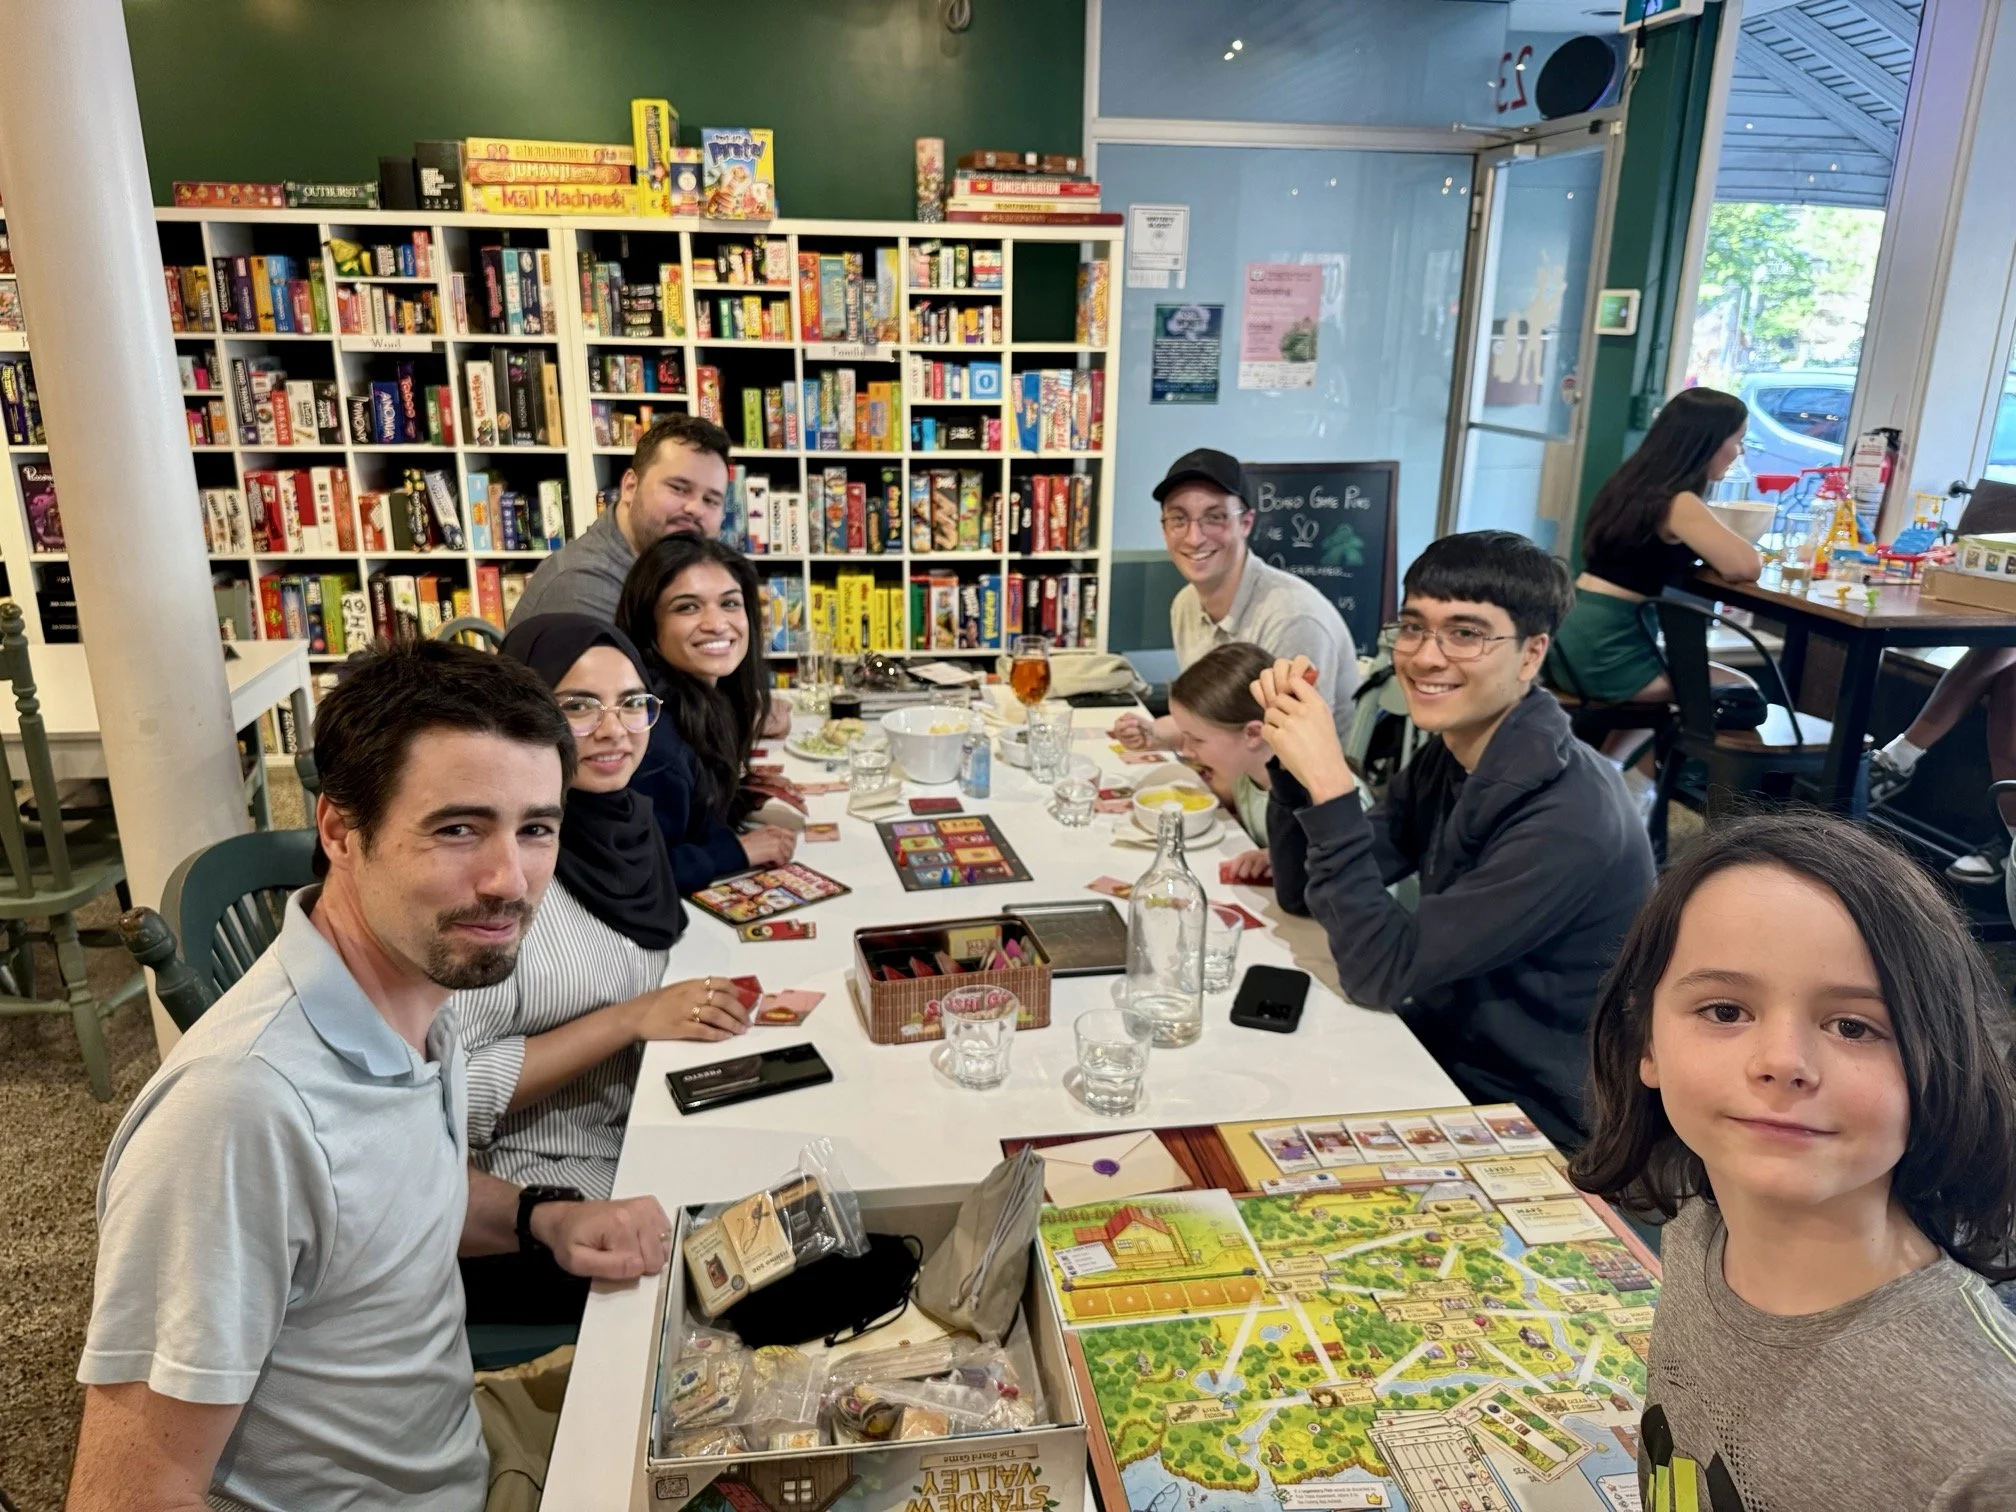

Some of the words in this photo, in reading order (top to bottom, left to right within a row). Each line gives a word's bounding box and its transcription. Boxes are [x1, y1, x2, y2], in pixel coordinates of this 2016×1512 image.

[504, 162, 571, 183] JUMANJI
[303, 186, 358, 198] OUTBURST
[501, 184, 538, 209] Mall
[216, 269, 229, 313] CODENAMES
[379, 390, 396, 442] ANOMIA
[683, 1068, 723, 1082] PRESTO
[943, 1454, 971, 1463] Game
[972, 1451, 998, 1462] Board
[1000, 1449, 1017, 1458] The
[919, 1461, 1038, 1497] VALLEY
[903, 1484, 1051, 1512] STARDEW
